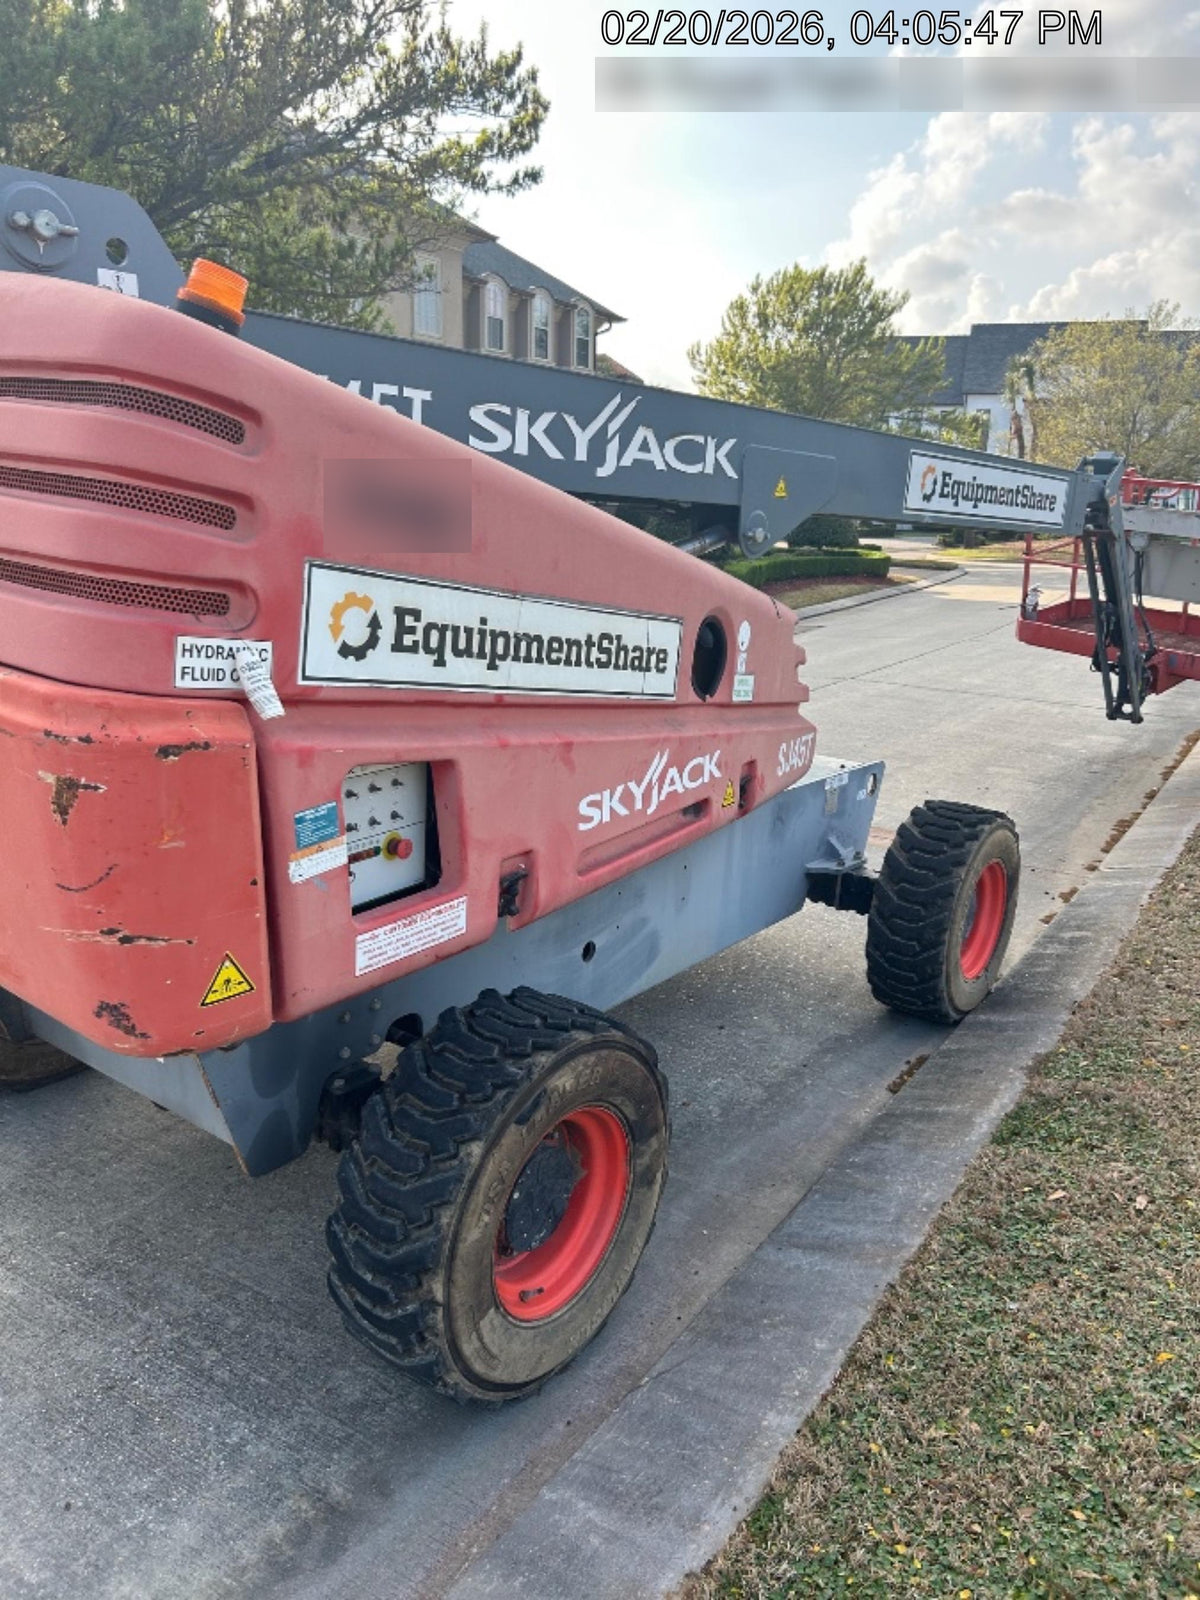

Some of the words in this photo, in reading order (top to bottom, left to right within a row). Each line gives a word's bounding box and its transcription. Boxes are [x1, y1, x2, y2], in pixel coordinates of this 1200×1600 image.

[468, 391, 738, 478] SKYJACK
[938, 471, 1057, 512] EquipmentShare
[181, 643, 269, 662] HYDRAC
[391, 606, 668, 674] EquipmentShare
[180, 666, 226, 682] FLUID
[577, 748, 722, 831] SKYJACK
